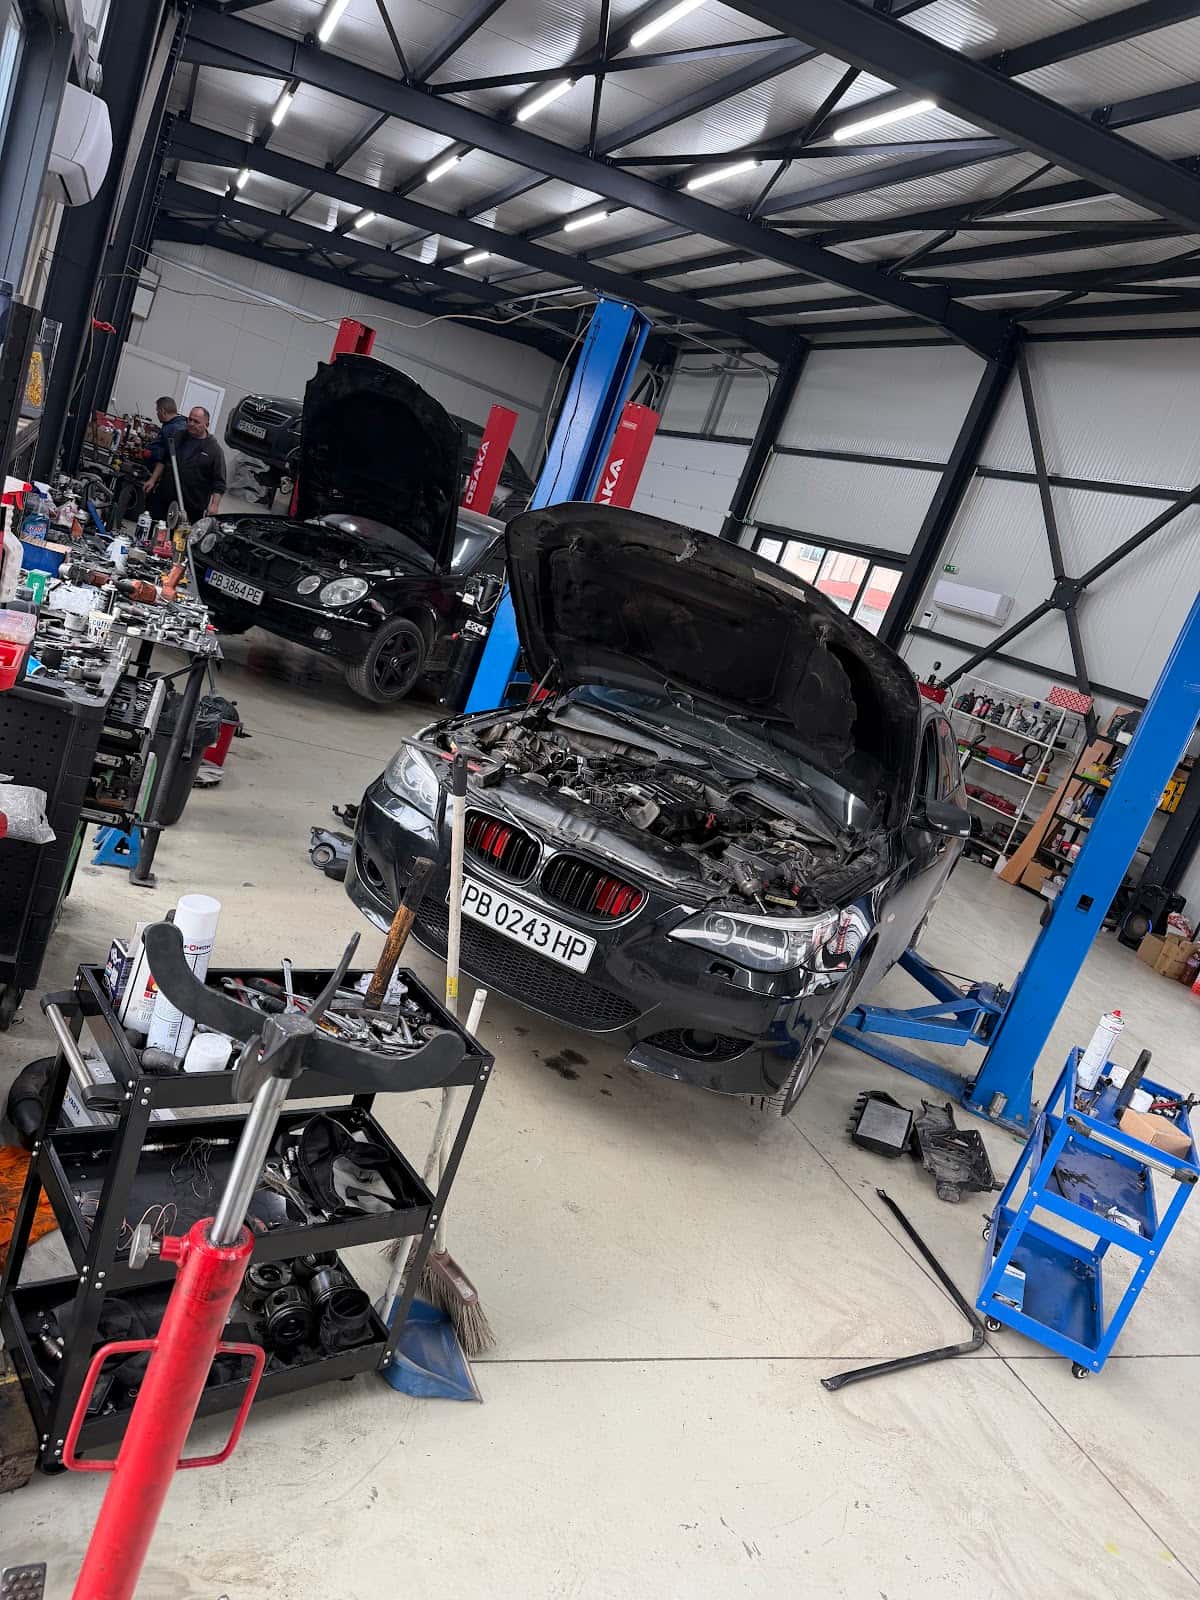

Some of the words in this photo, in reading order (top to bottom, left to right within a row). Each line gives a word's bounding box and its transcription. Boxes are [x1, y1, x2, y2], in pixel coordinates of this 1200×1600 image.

[465, 440, 491, 505] OSAKA
[211, 573, 223, 586] PB
[223, 578, 246, 597] 3864
[246, 587, 262, 604] PE
[462, 884, 493, 918] PB
[495, 903, 551, 947] 0243
[551, 930, 588, 962] HP
